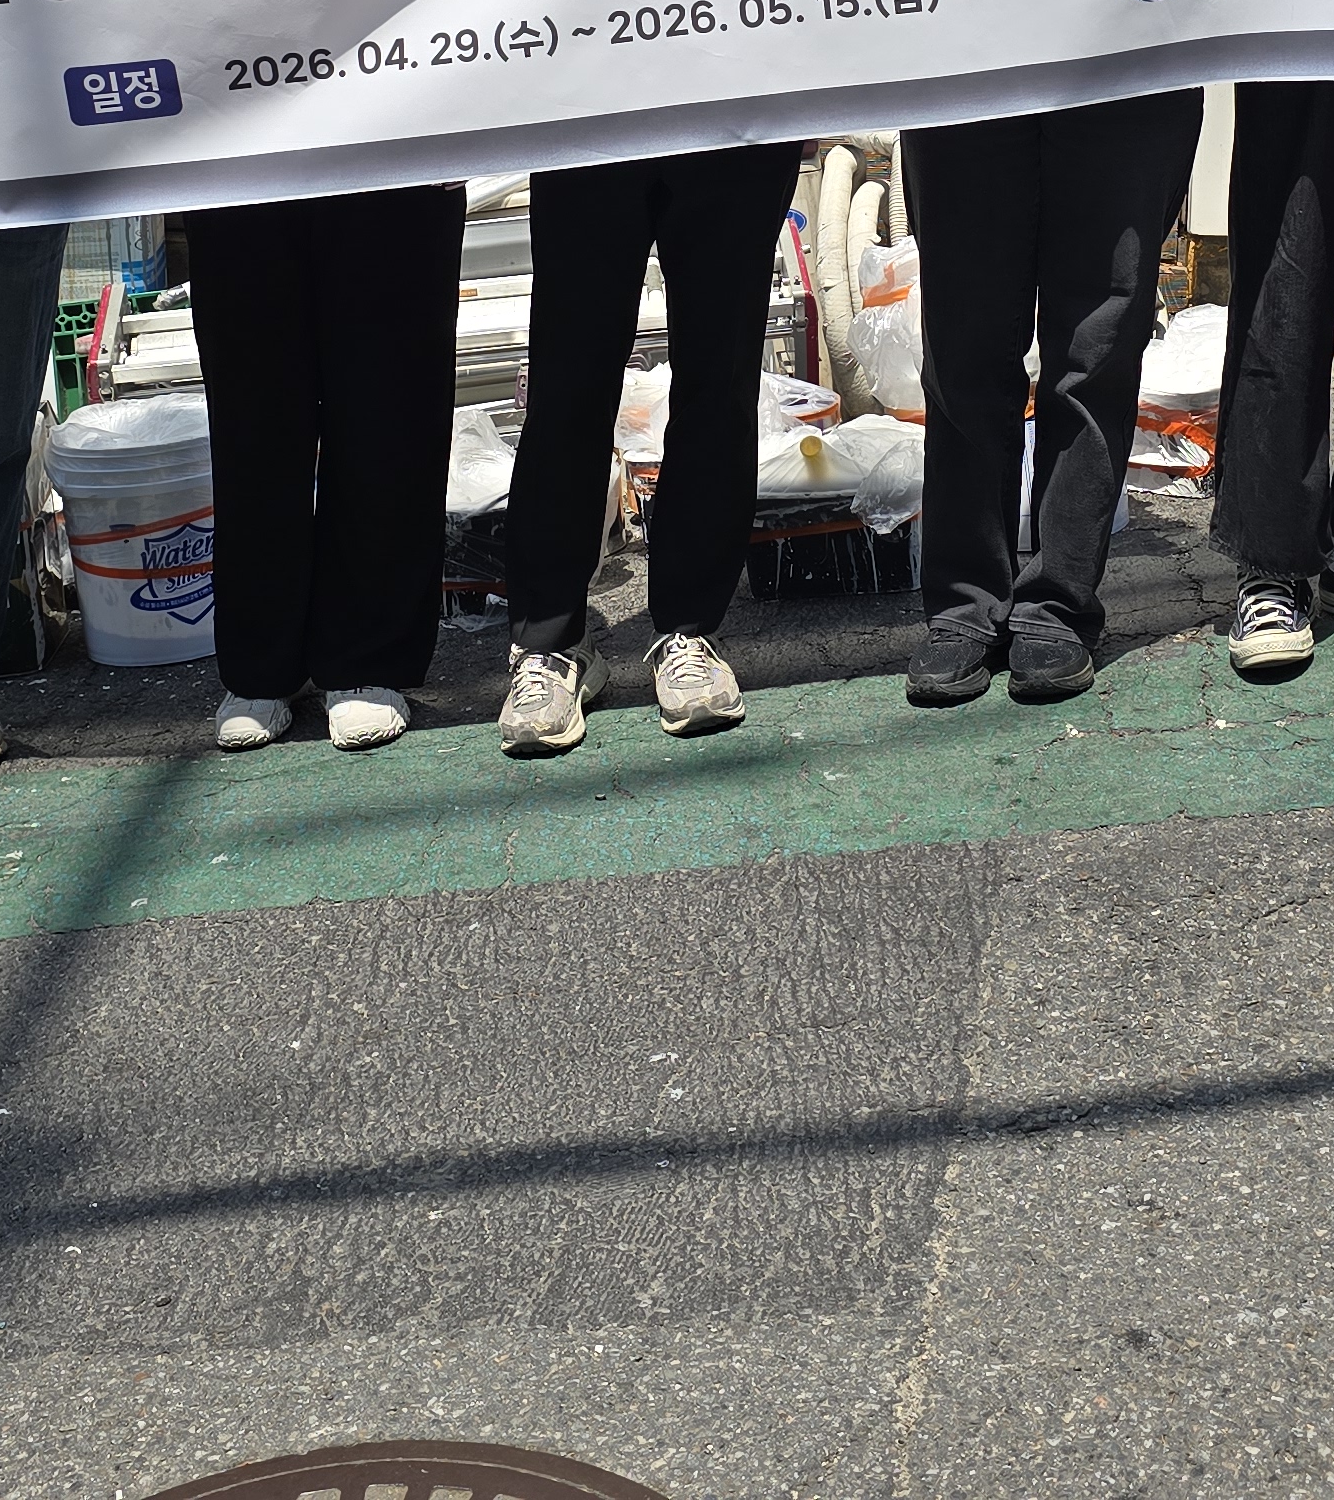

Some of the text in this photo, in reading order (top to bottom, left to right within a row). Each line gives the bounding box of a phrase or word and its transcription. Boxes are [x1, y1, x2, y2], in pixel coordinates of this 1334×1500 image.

[224, 47, 347, 92] 2026.
[356, 37, 419, 75] 04.
[429, 14, 559, 65] 29.(수)
[607, 0, 728, 45] 2026.
[82, 69, 162, 114] 일정
